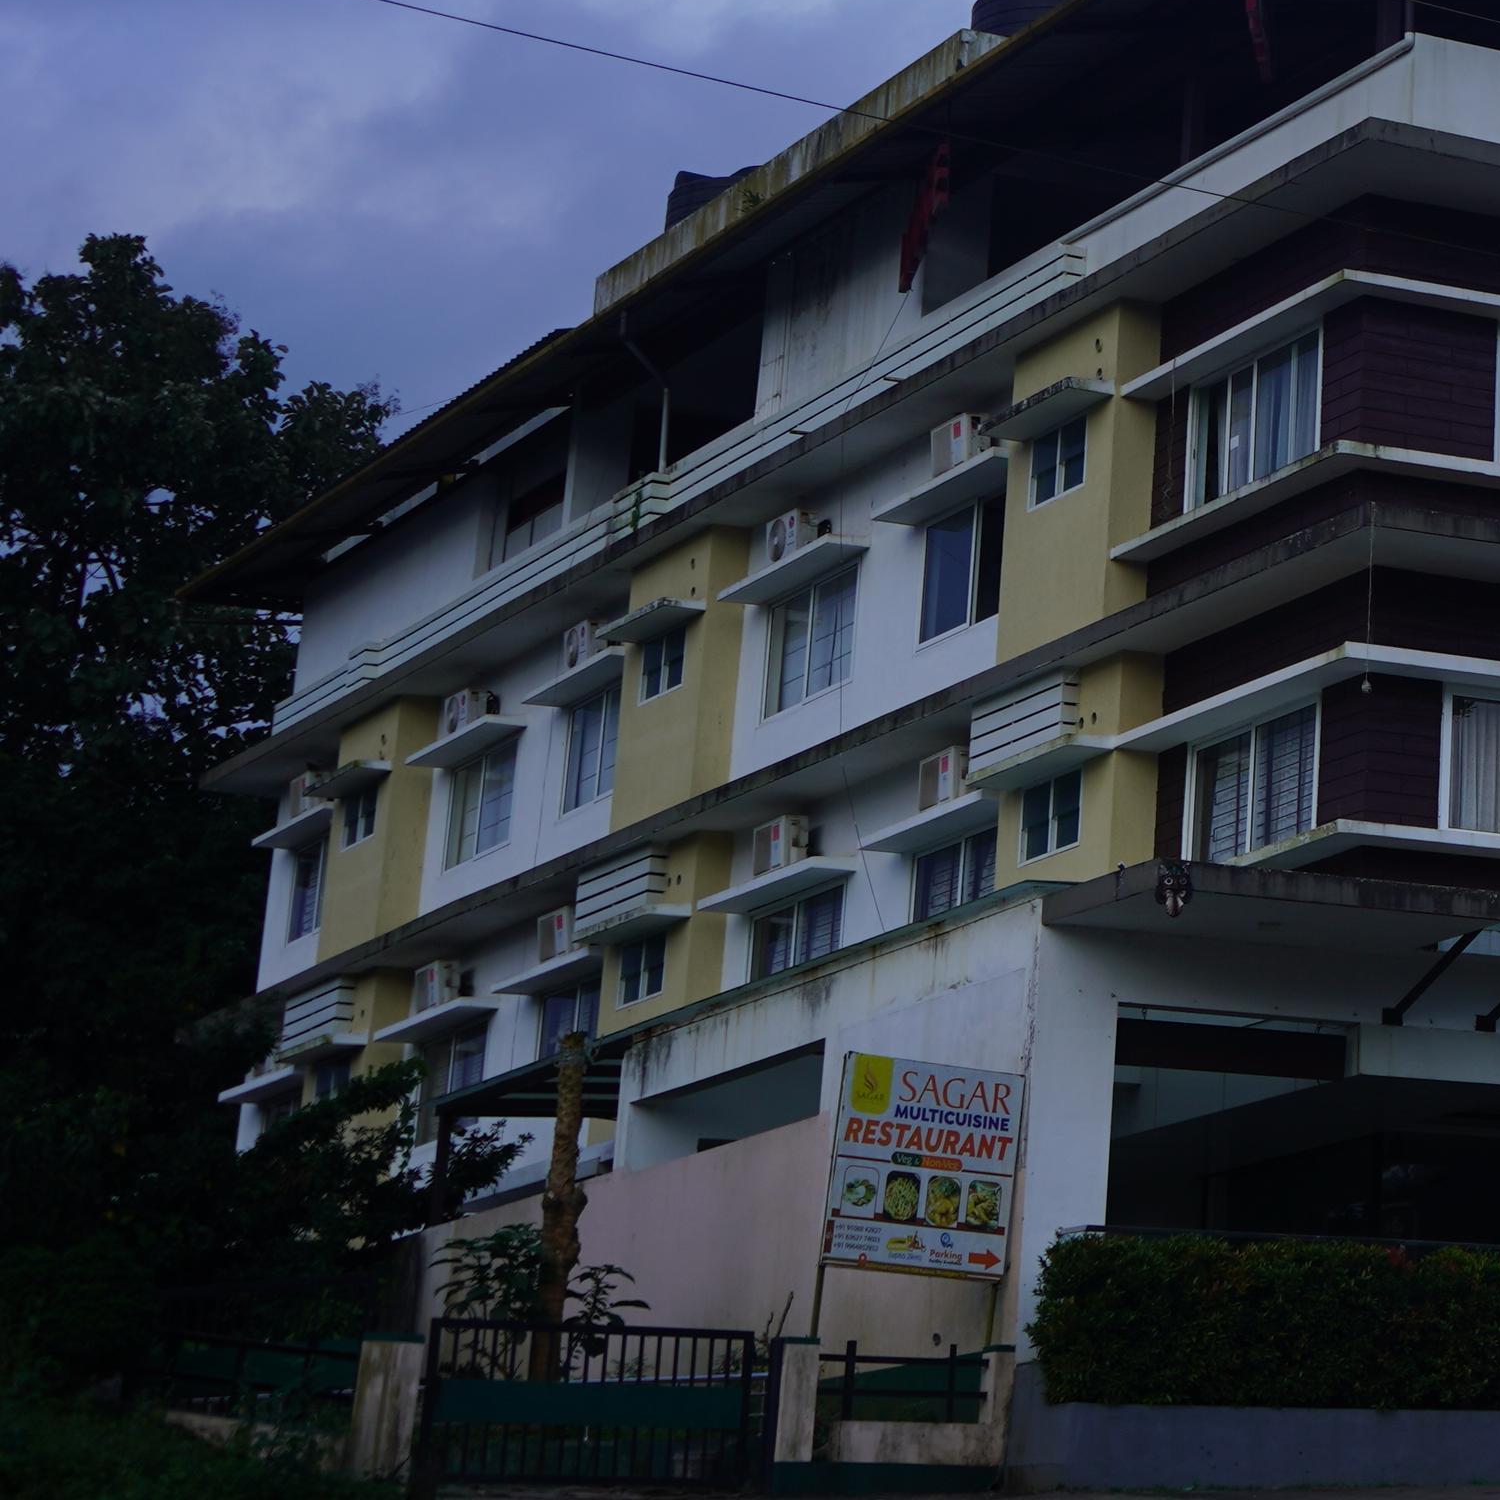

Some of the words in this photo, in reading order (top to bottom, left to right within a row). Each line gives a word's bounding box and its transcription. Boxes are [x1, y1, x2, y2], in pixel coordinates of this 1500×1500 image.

[898, 1070, 1012, 1115] SAGAR
[894, 1103, 1010, 1132] MULTICUISINE
[844, 1116, 1013, 1161] RESTAURANT
[929, 1249, 963, 1263] Parking
